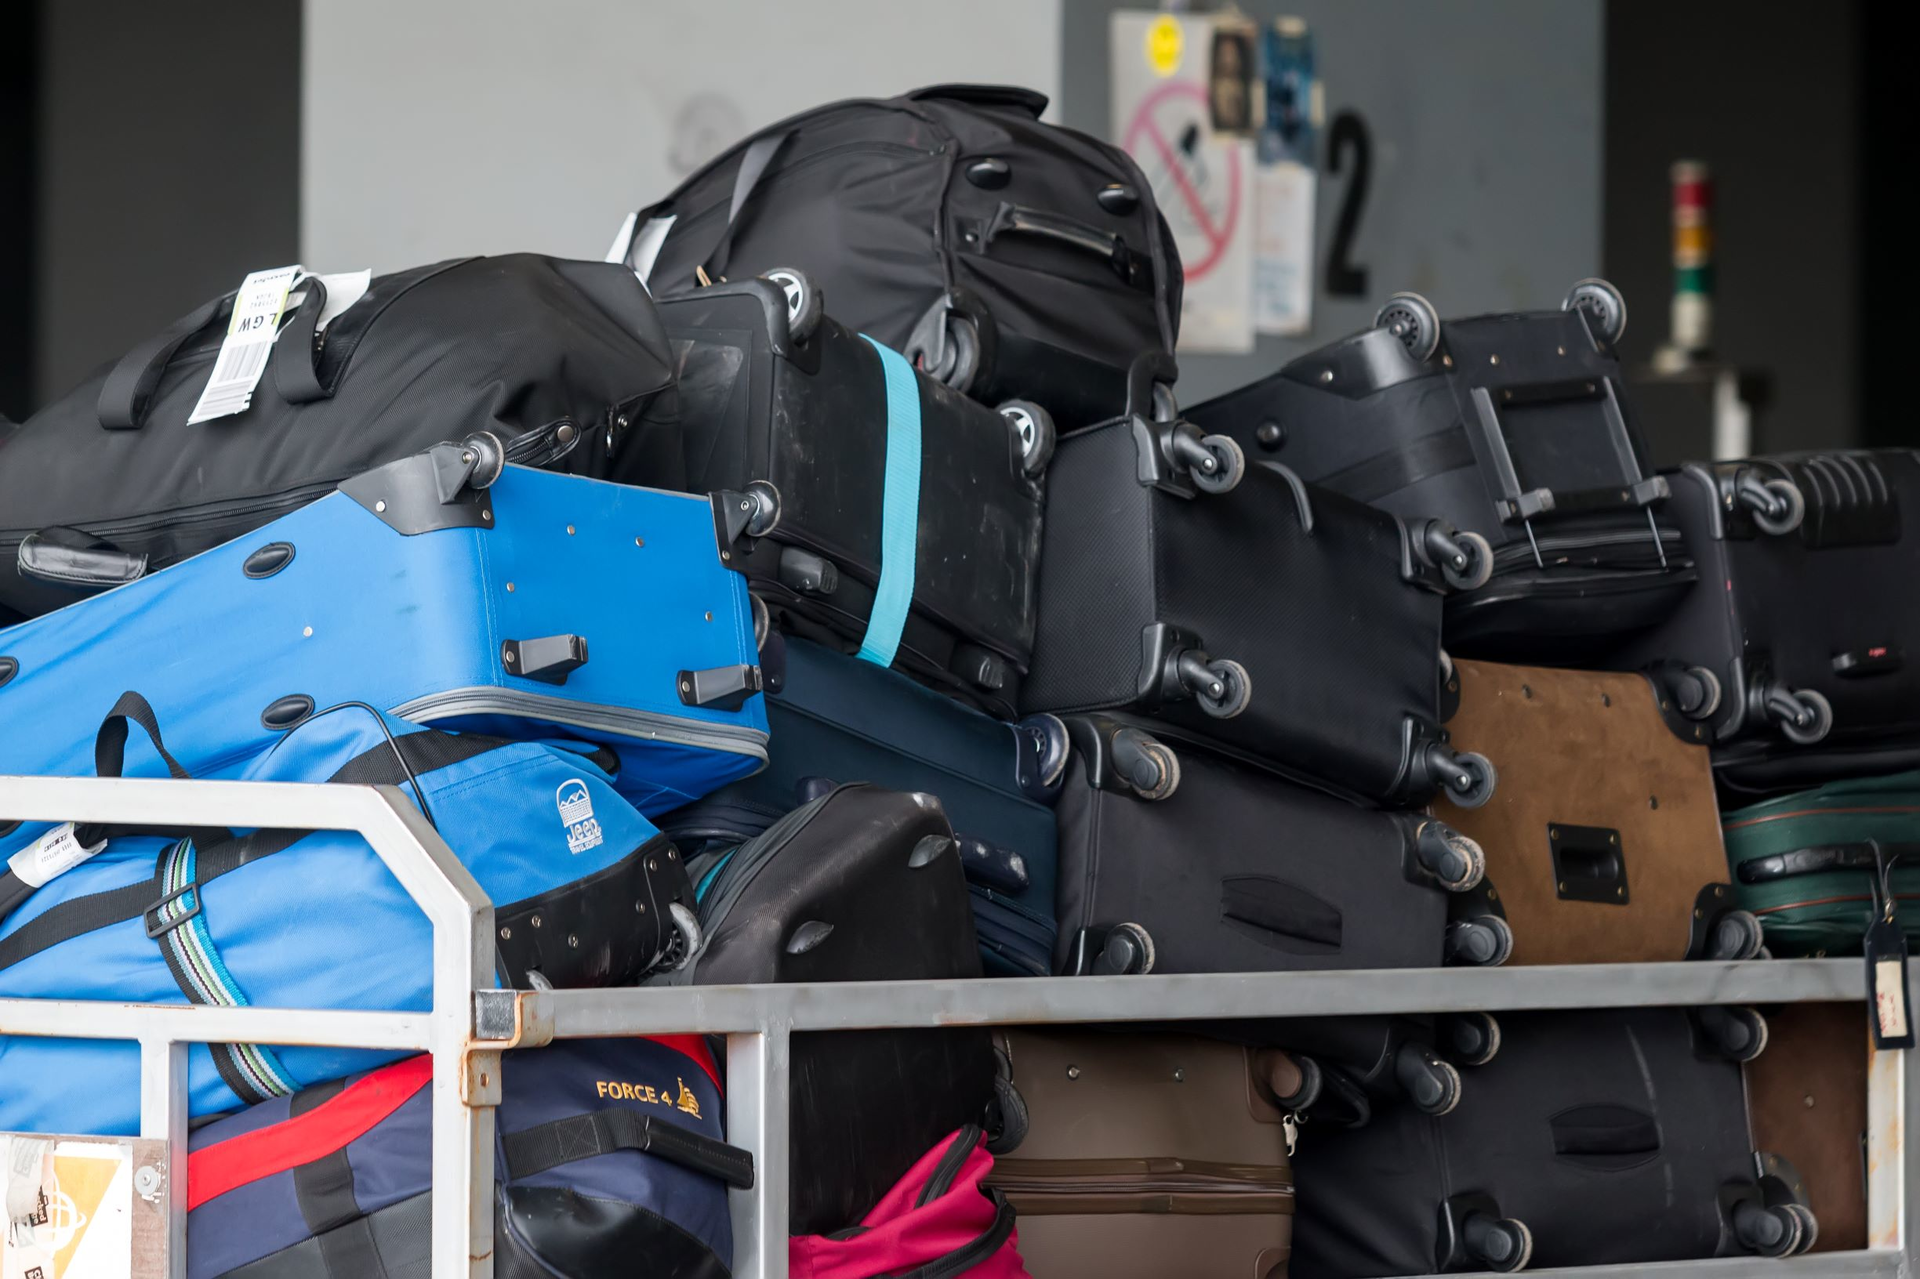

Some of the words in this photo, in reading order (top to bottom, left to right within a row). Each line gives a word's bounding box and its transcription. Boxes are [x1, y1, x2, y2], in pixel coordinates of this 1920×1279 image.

[1325, 106, 1372, 297] 2
[238, 312, 278, 333] LGW
[566, 818, 601, 843] Jeep
[596, 1081, 659, 1104] FORCE
[660, 1090, 673, 1107] 4
